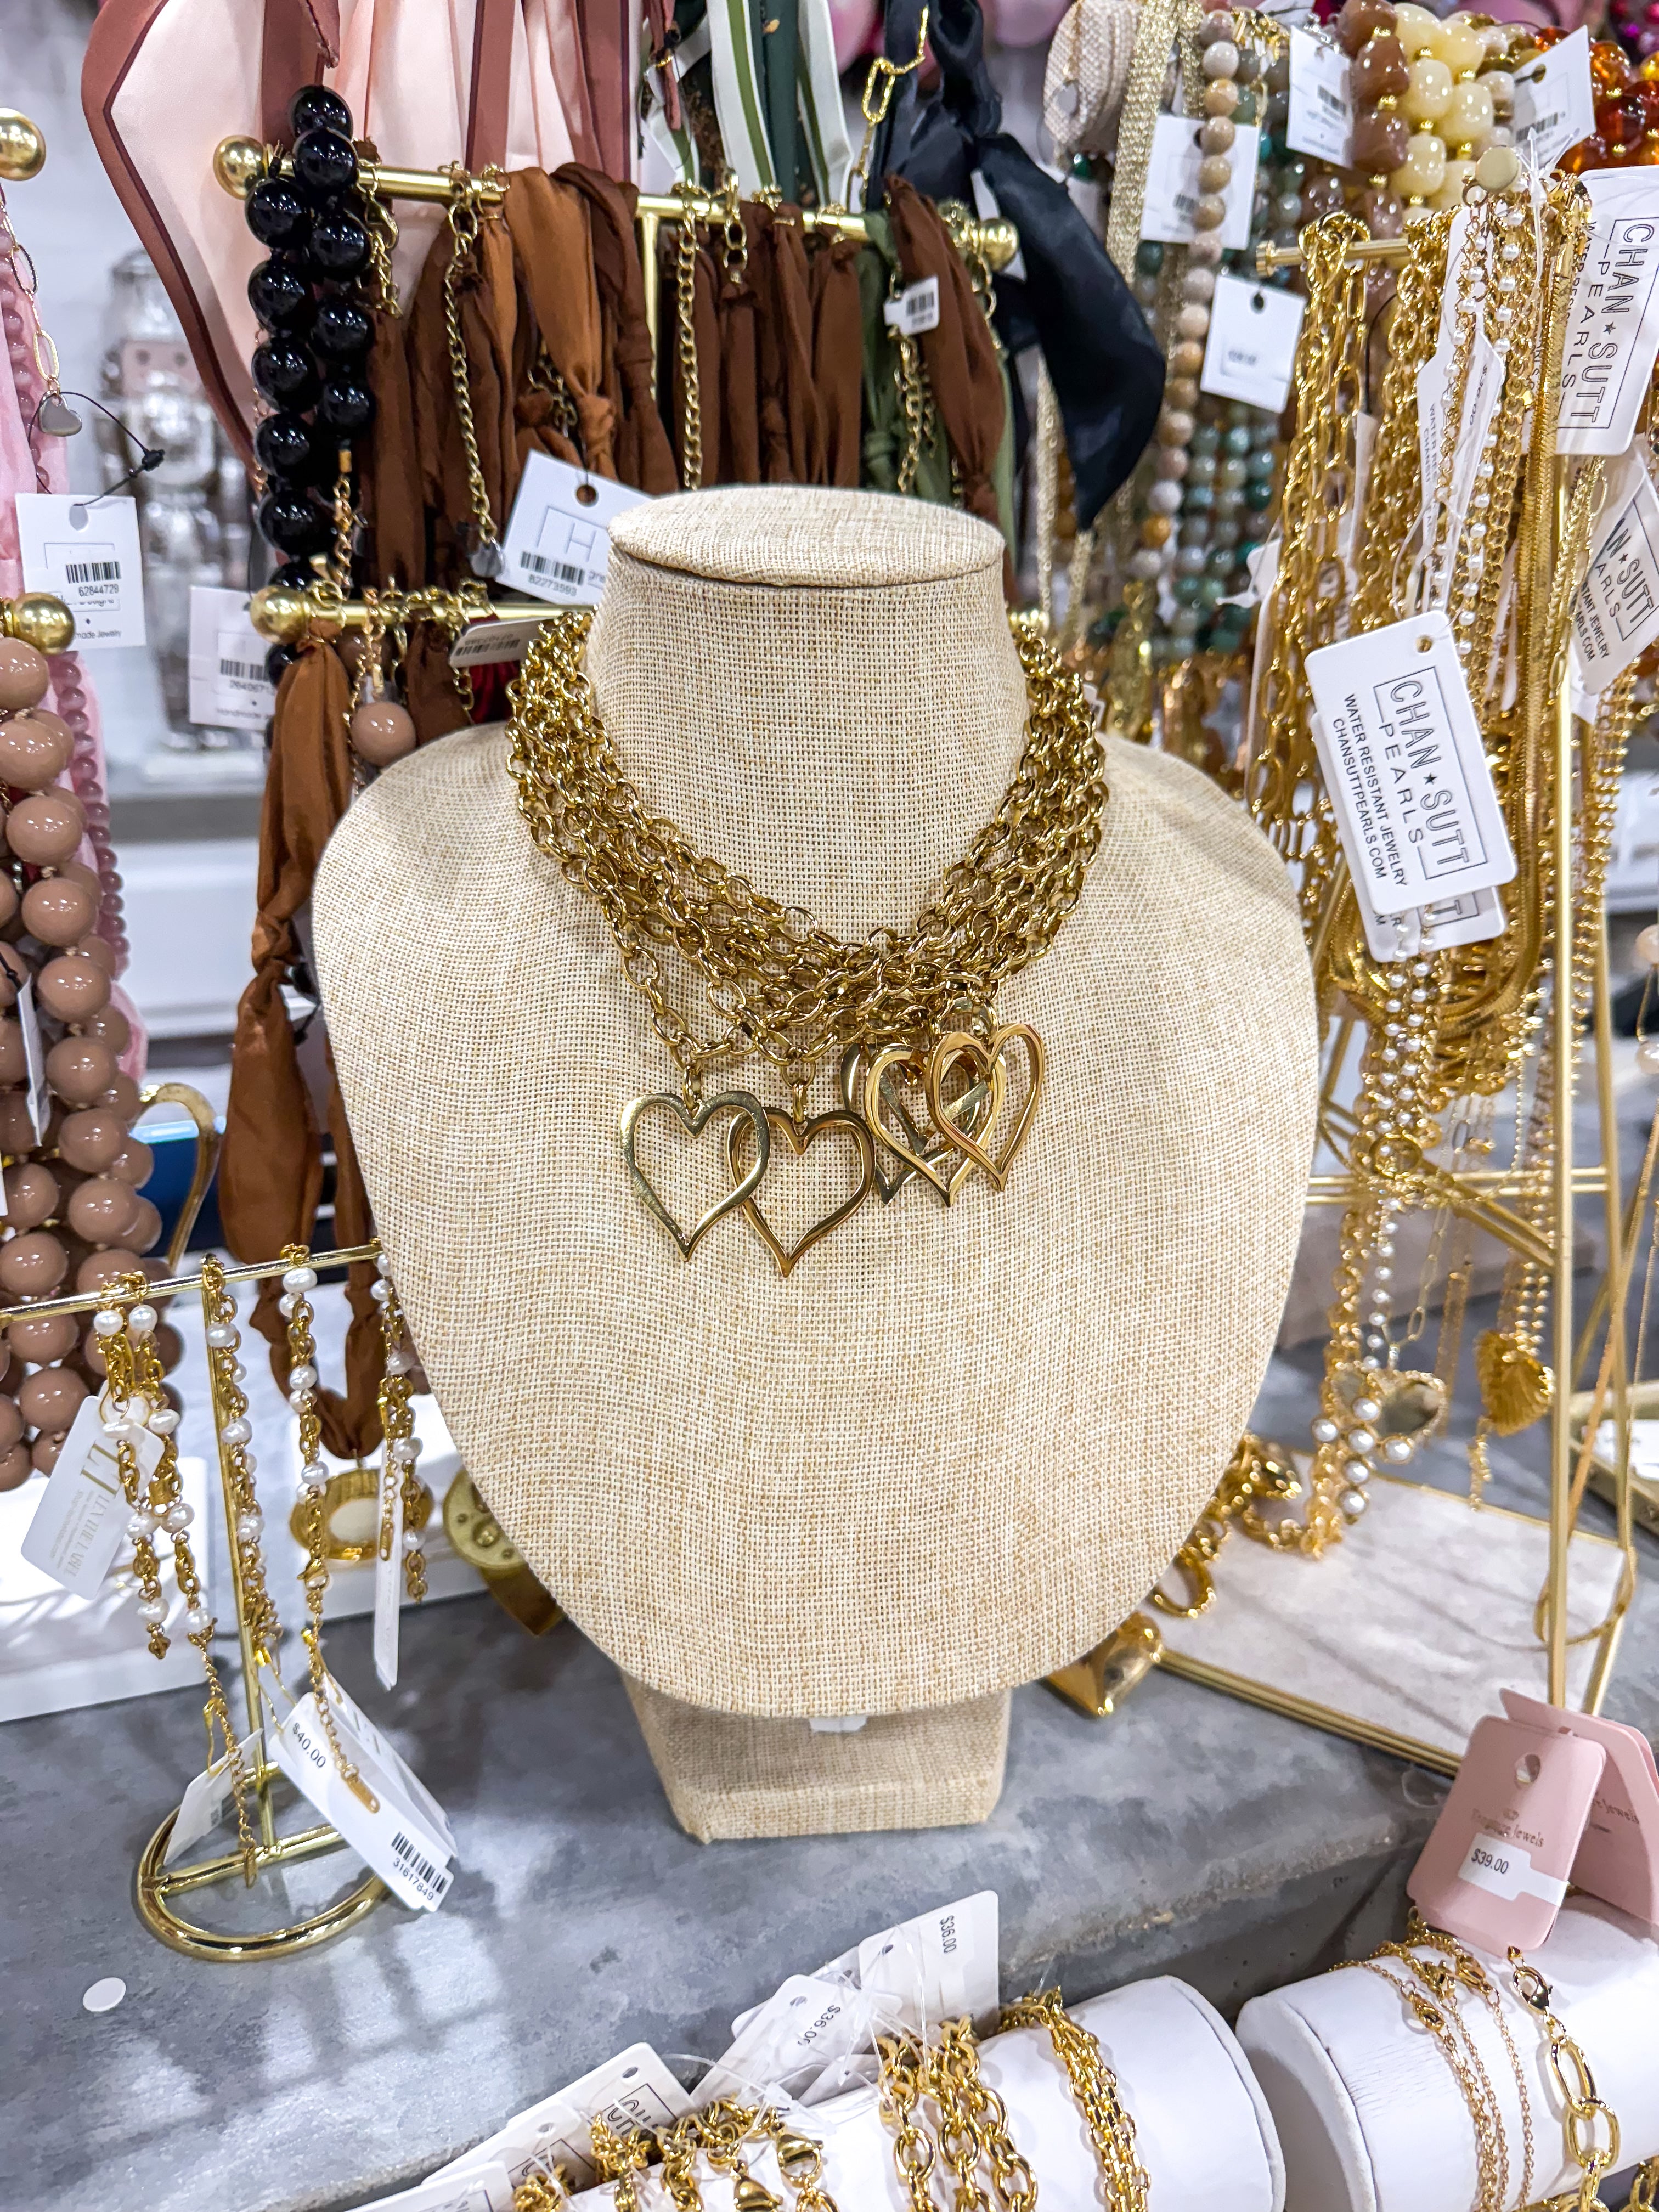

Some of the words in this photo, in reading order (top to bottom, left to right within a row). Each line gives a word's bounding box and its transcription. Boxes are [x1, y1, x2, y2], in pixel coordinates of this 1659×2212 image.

[1601, 223, 1655, 314] CHAN
[1561, 261, 1611, 389] PEARLS
[1570, 341, 1618, 424] SUTT
[1594, 563, 1621, 618] ARLS
[1617, 558, 1654, 624] SUTT
[1589, 613, 1609, 659] JEWELRY
[1333, 718, 1387, 879] CHANSUTTPEARLS.COM
[1344, 693, 1367, 744] WATER
[1358, 747, 1389, 821] RESISTANT
[1379, 824, 1407, 887] JEWELRY
[1379, 721, 1424, 844] PEARLS
[1391, 679, 1442, 769] CHAN
[1421, 789, 1470, 866] SUTT
[292, 1722, 326, 1769] $40.00
[1471, 1848, 1509, 1875] $39.00
[1511, 1824, 1544, 1848] Jewels
[392, 1857, 435, 1901] 31617849
[940, 1915, 957, 1954] $36.00
